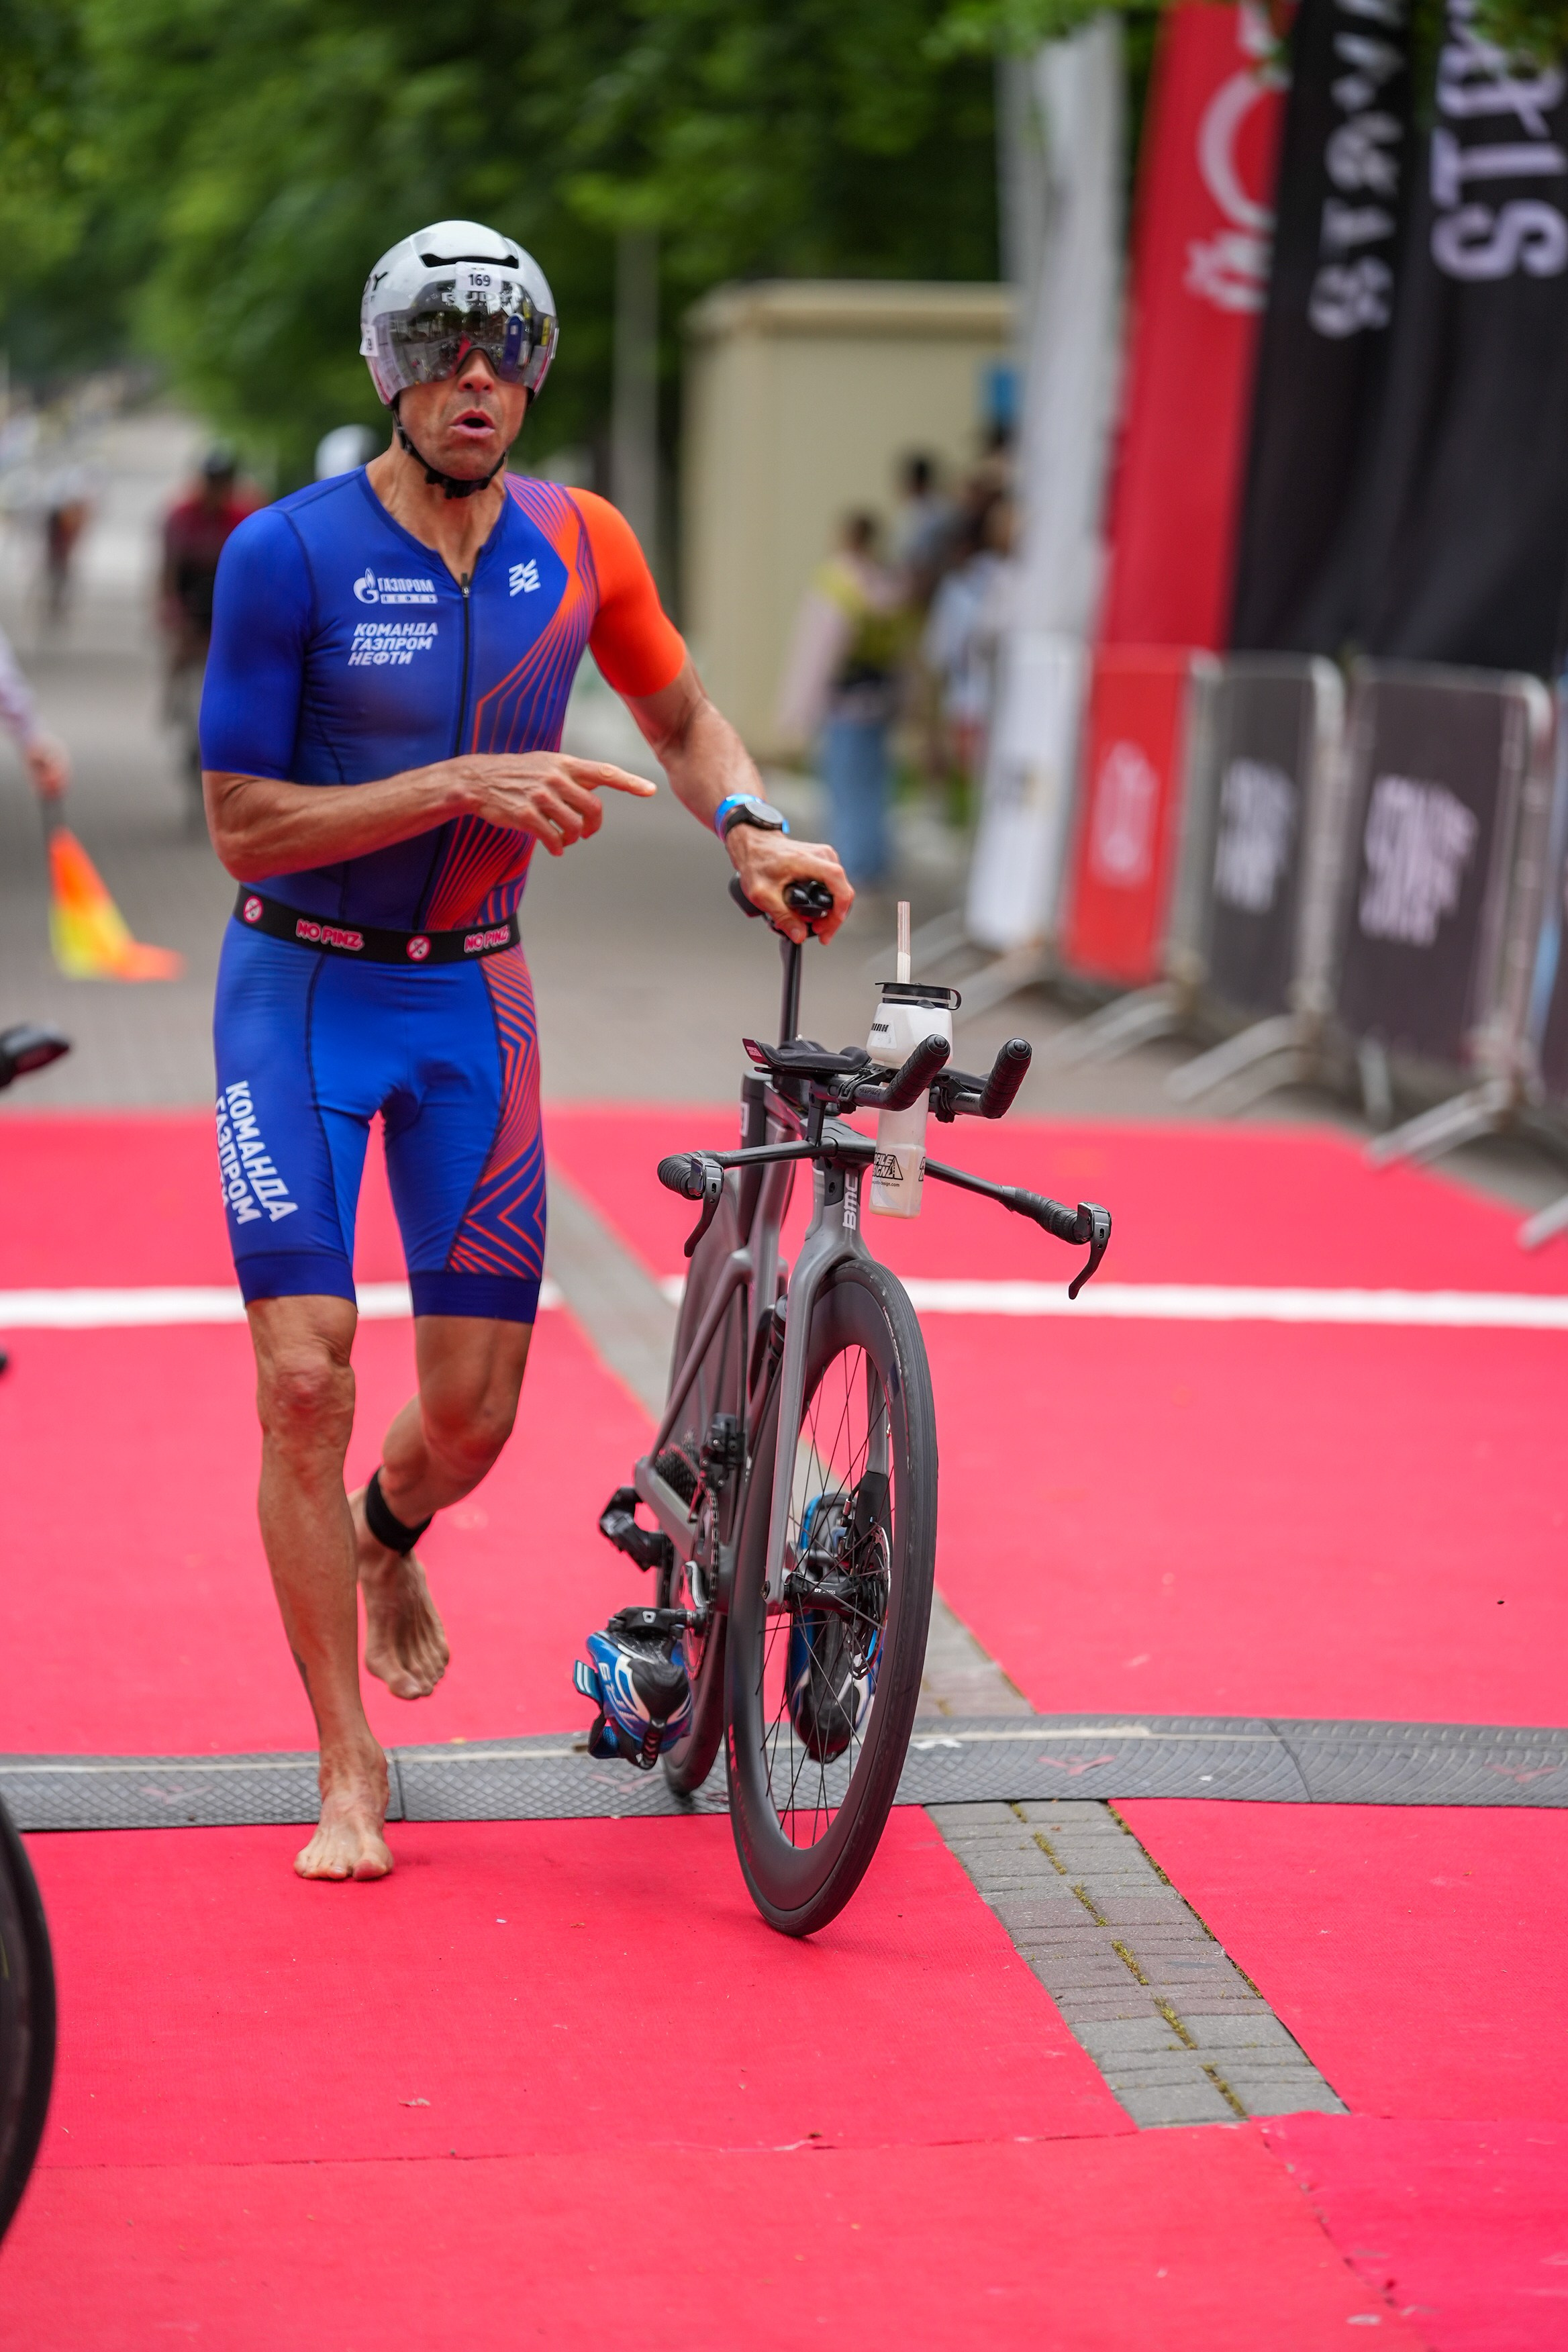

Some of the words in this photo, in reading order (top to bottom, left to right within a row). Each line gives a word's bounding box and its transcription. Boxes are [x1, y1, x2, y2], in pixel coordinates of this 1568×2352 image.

[469, 273, 491, 287] 169
[377, 577, 436, 592] ГАЗПРОМ
[353, 622, 438, 636] КОМАНДА
[350, 636, 433, 651] ГАЗПРОМ
[348, 650, 413, 666] НЕФТИ
[296, 918, 322, 942] NO
[321, 926, 365, 951] PINZ
[464, 932, 484, 953] NO
[483, 924, 511, 950] PINZ
[215, 1095, 262, 1225] ГАЗПРОМ
[226, 1080, 299, 1222] КОМАНДА
[842, 1173, 859, 1230] BMC
